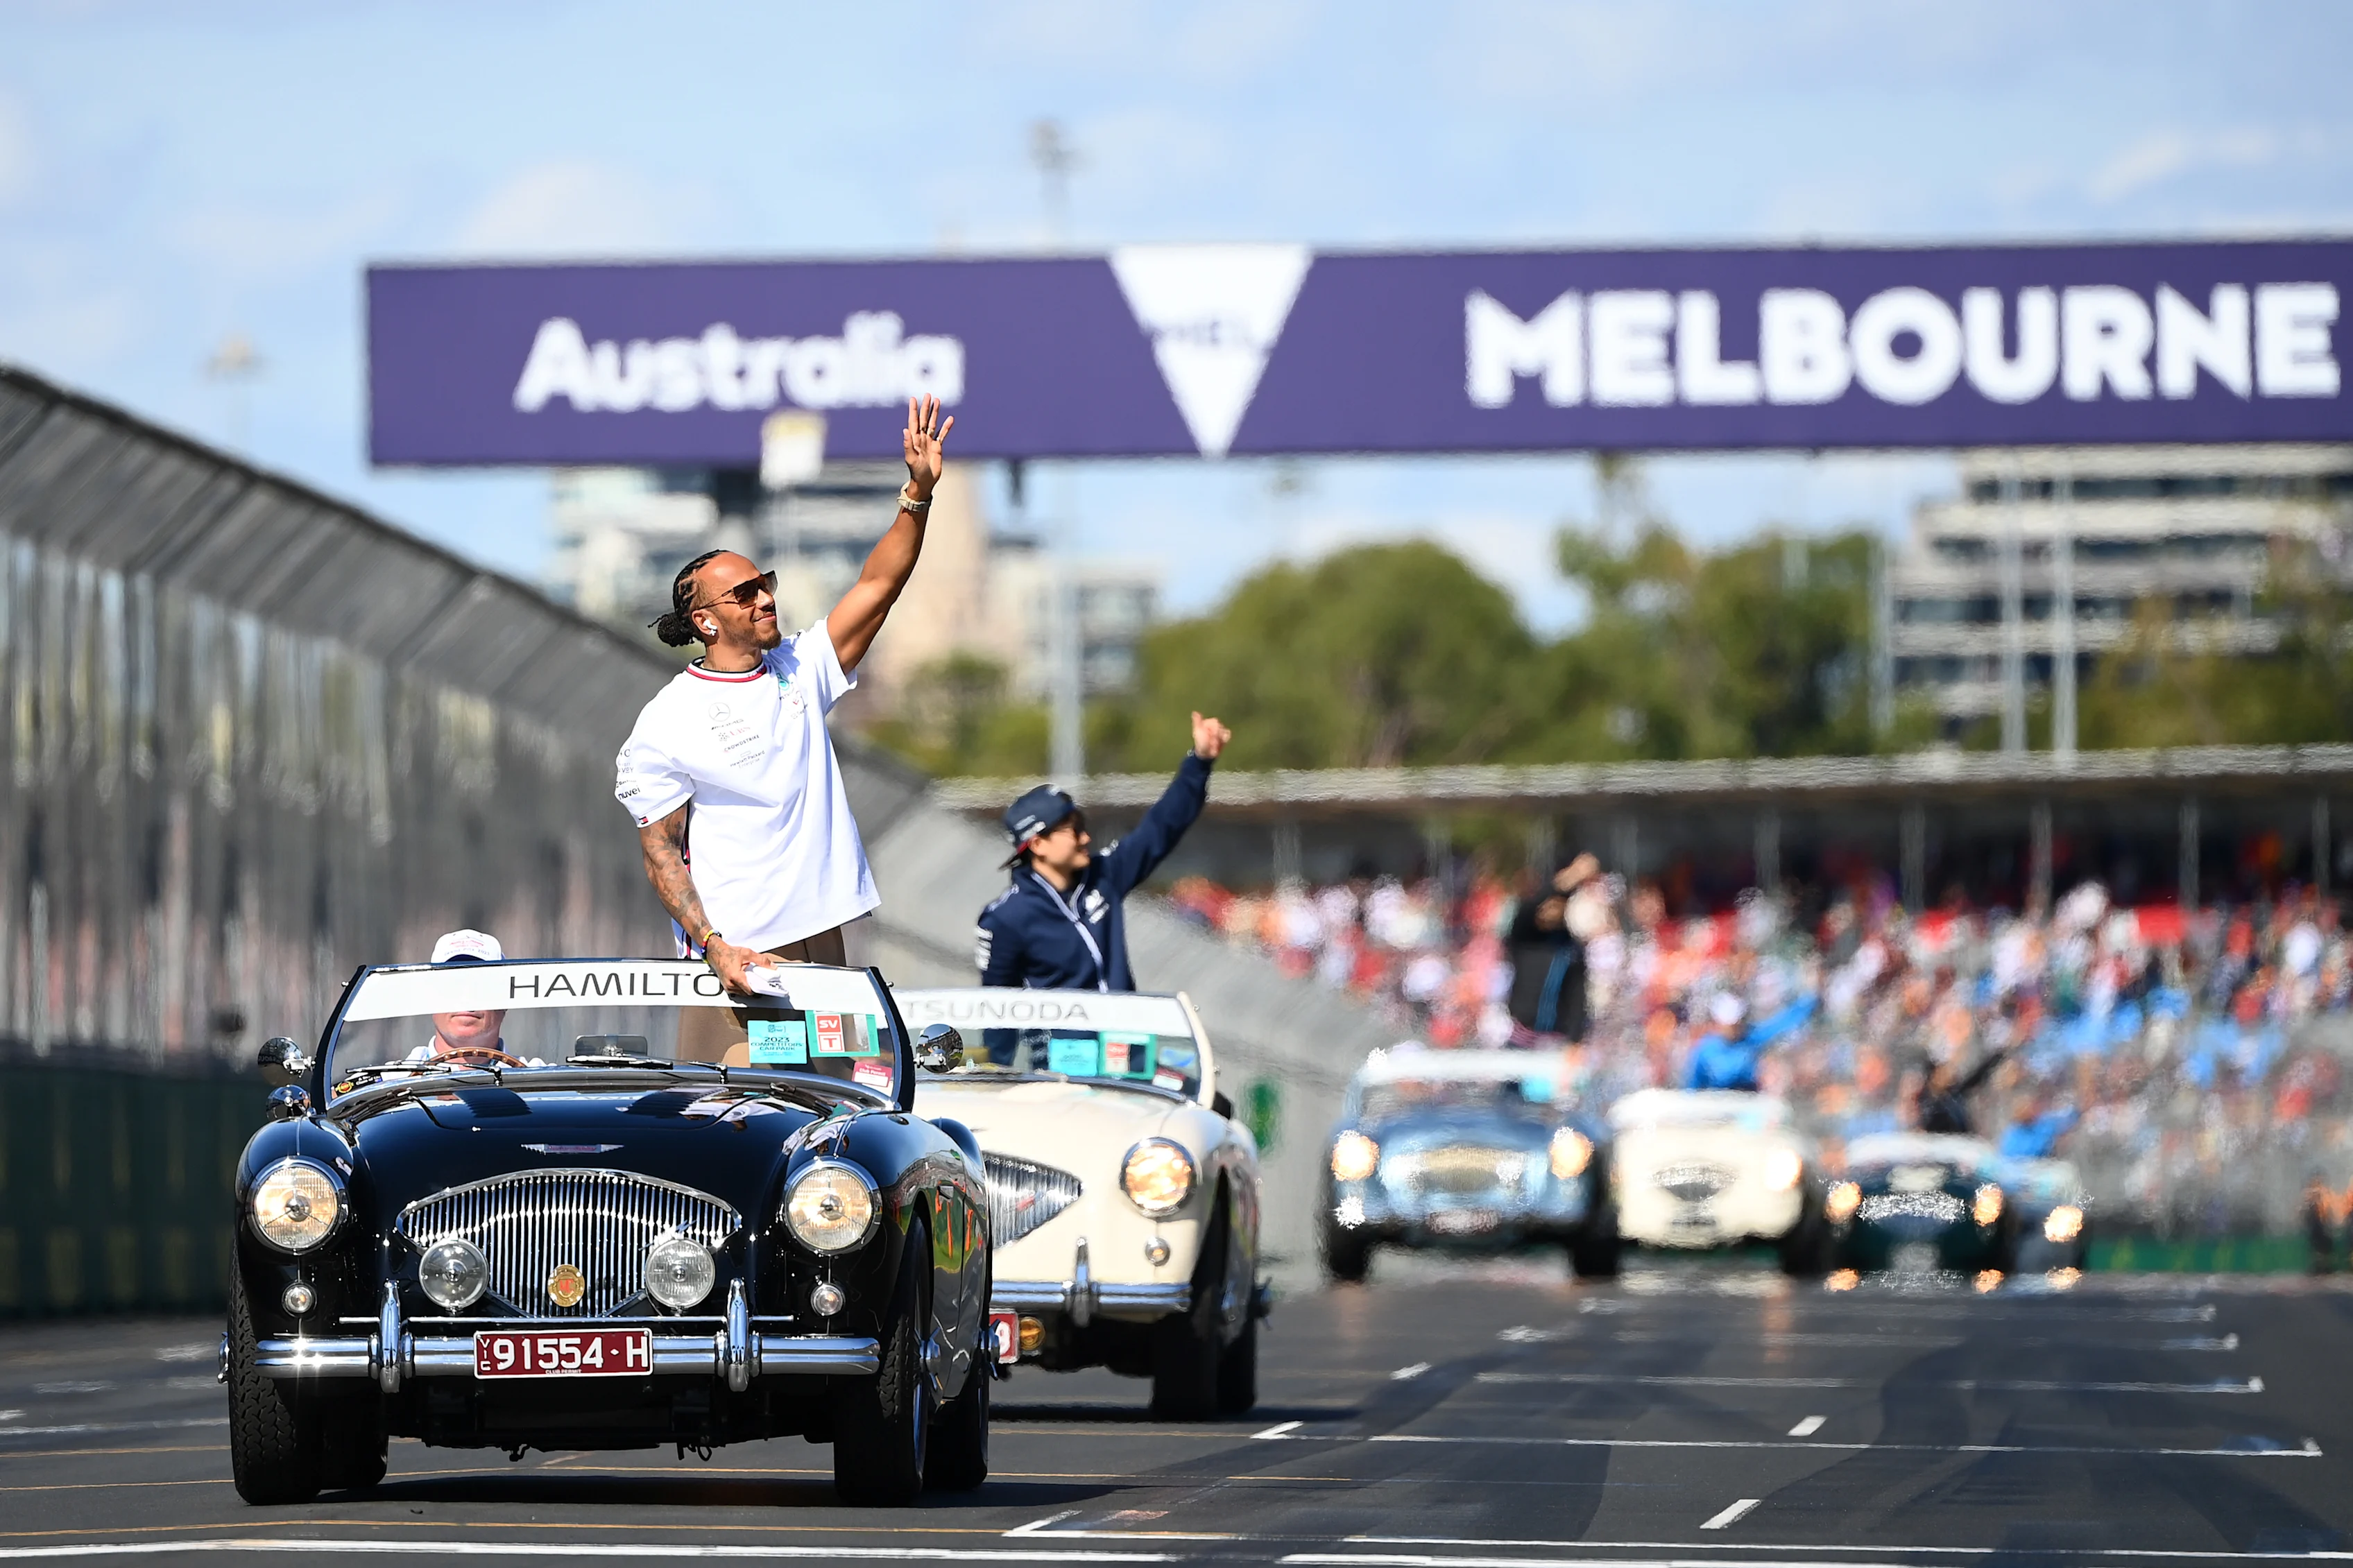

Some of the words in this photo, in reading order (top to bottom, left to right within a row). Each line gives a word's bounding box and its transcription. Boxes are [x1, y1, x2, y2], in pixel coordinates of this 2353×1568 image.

[1465, 283, 2341, 408] MELBOURNE
[515, 311, 964, 413] Australia
[724, 734, 760, 752] CROWDSTRIKE
[618, 785, 641, 800] nuvei
[510, 972, 724, 999] HAMILTO
[902, 1000, 1090, 1022] TSUNODA
[819, 1019, 838, 1028] SV
[823, 1037, 837, 1048] T
[480, 1338, 490, 1370] VIC
[493, 1337, 604, 1369] 91554
